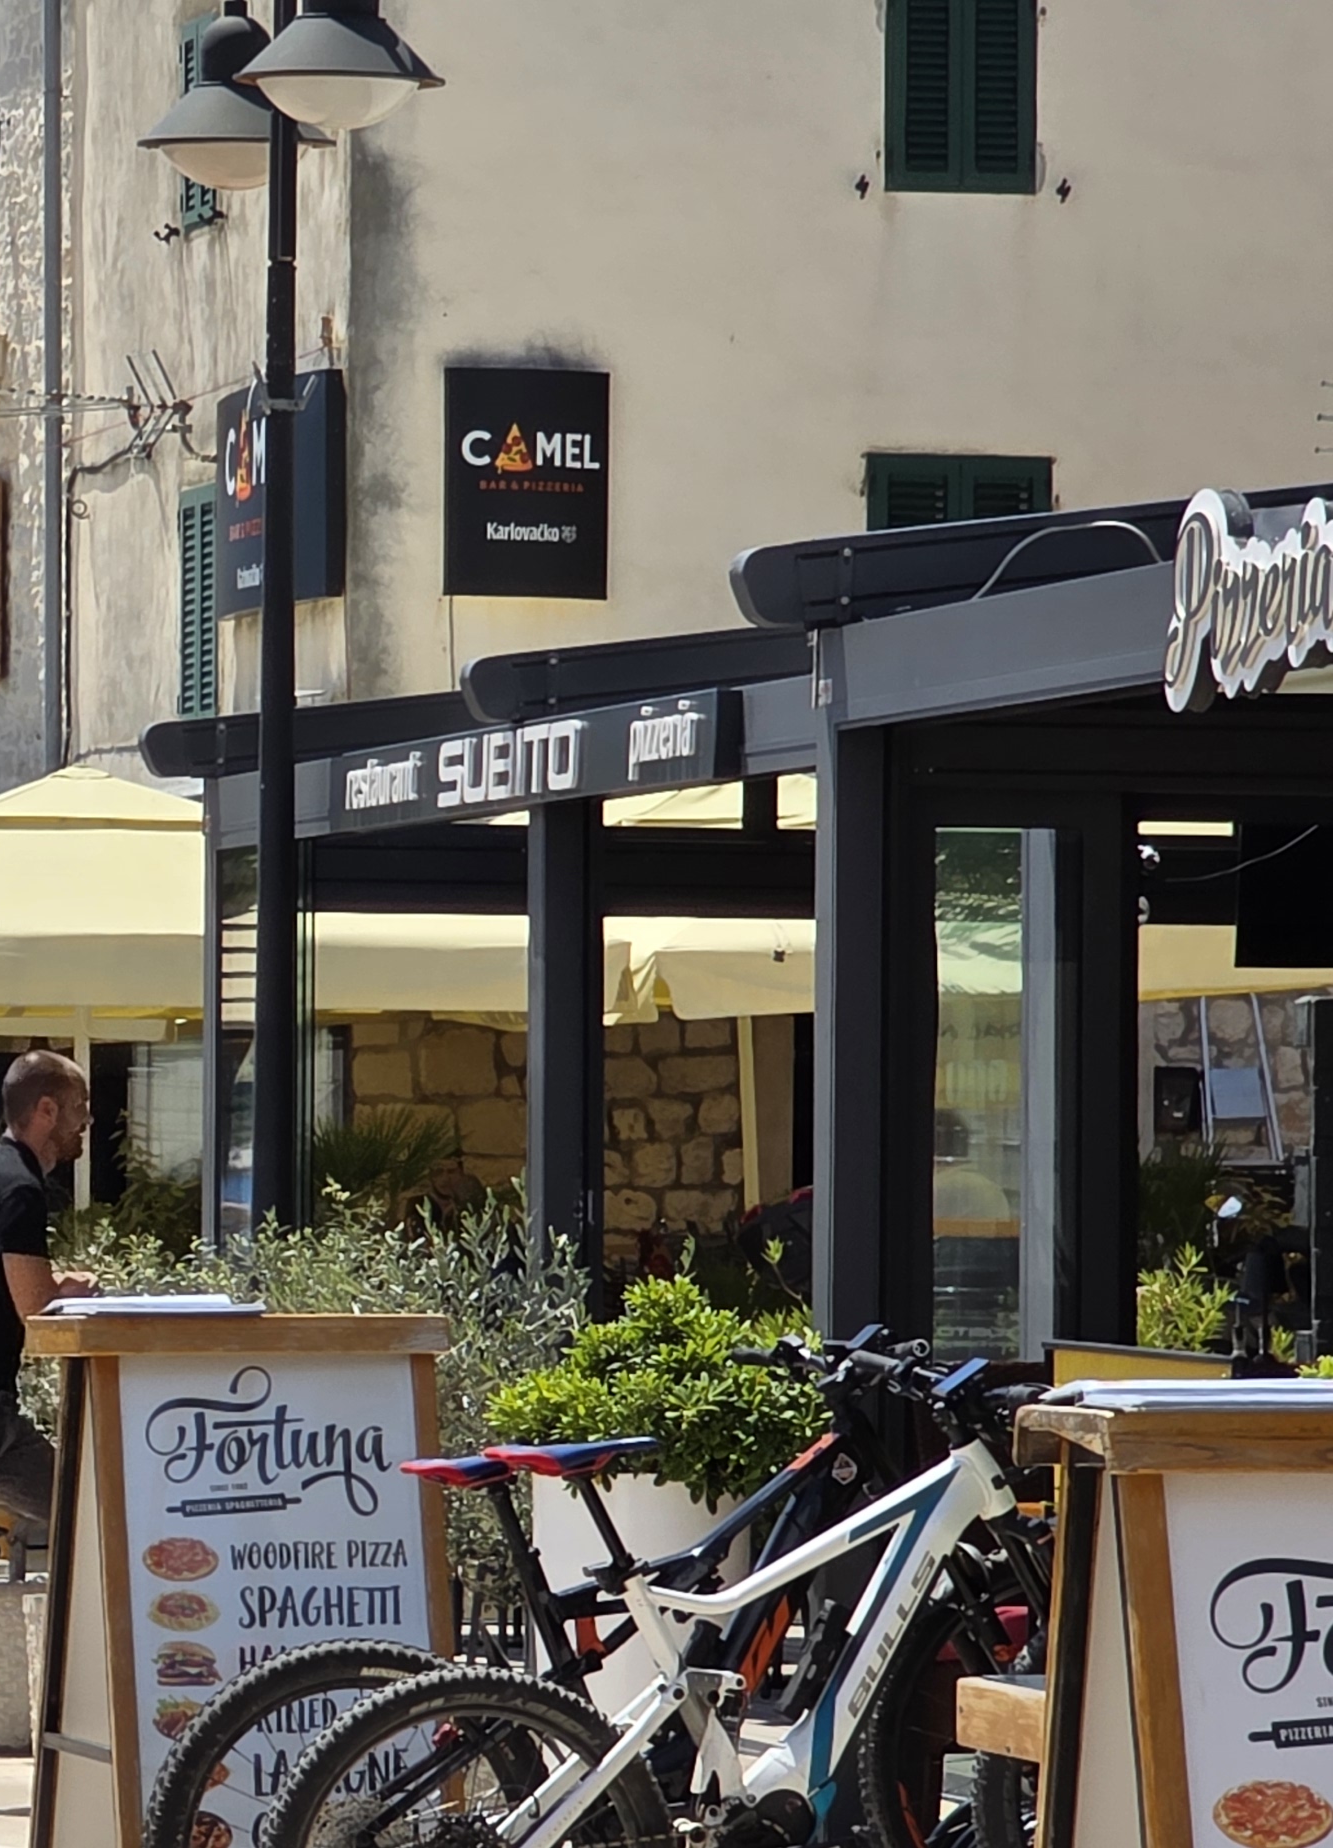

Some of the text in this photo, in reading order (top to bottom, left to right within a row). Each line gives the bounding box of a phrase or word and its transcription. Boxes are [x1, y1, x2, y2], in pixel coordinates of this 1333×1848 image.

[225, 407, 266, 496] CAM
[523, 481, 584, 492] PIZZERIA
[486, 522, 560, 542] Karlovačko
[1164, 500, 1333, 700] Pizzeria
[344, 699, 705, 810] restaurant SUBITO pizzeria
[145, 1365, 392, 1517] Fortuna
[230, 1538, 408, 1571] WOODFIRE PIZZA
[238, 1584, 402, 1630] SPAGHETTI
[847, 1550, 936, 1719] BULLS
[253, 1749, 409, 1797] LAGNE
